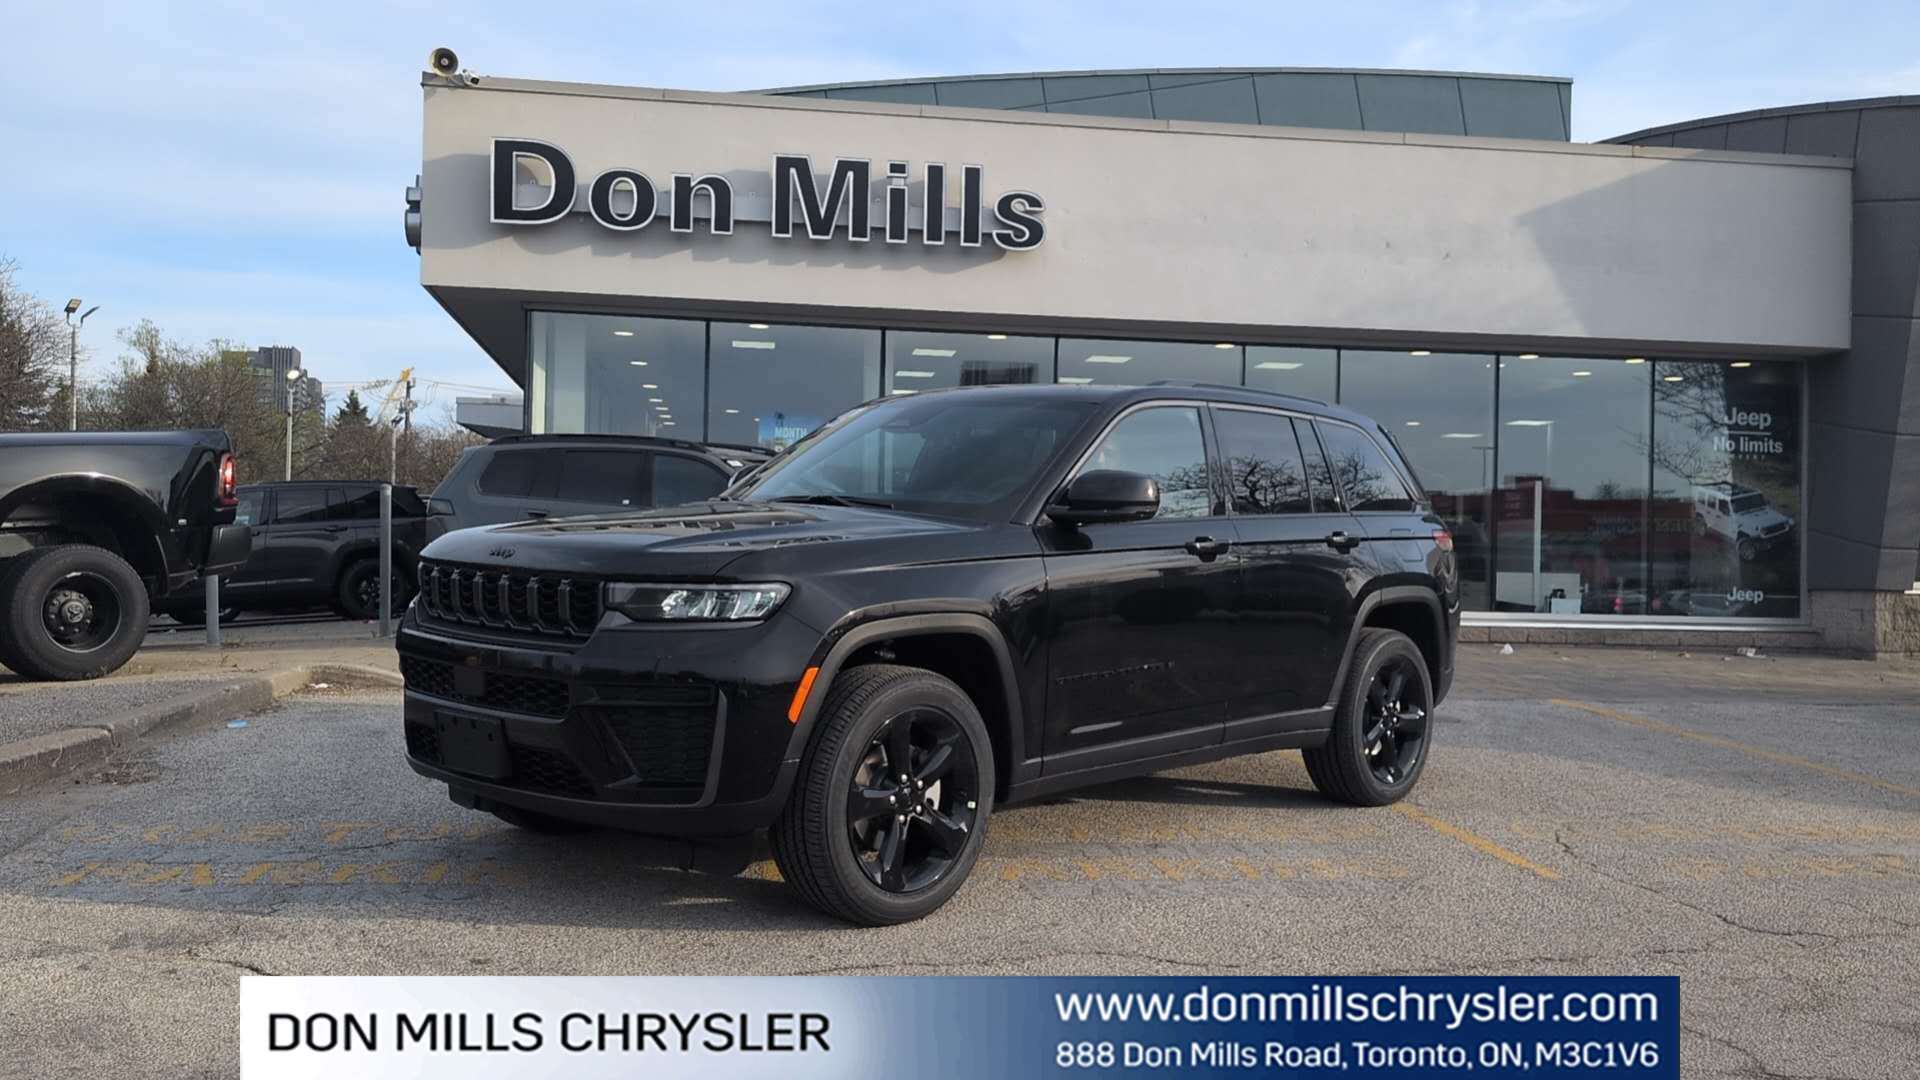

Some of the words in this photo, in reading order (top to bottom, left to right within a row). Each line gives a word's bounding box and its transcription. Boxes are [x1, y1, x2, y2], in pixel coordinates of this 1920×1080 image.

[490, 136, 735, 236] Don
[771, 153, 1046, 251] Mills
[1723, 407, 1772, 429] Jeep
[1713, 436, 1736, 452] No
[1740, 436, 1783, 453] limits
[1727, 587, 1764, 604] Jeep
